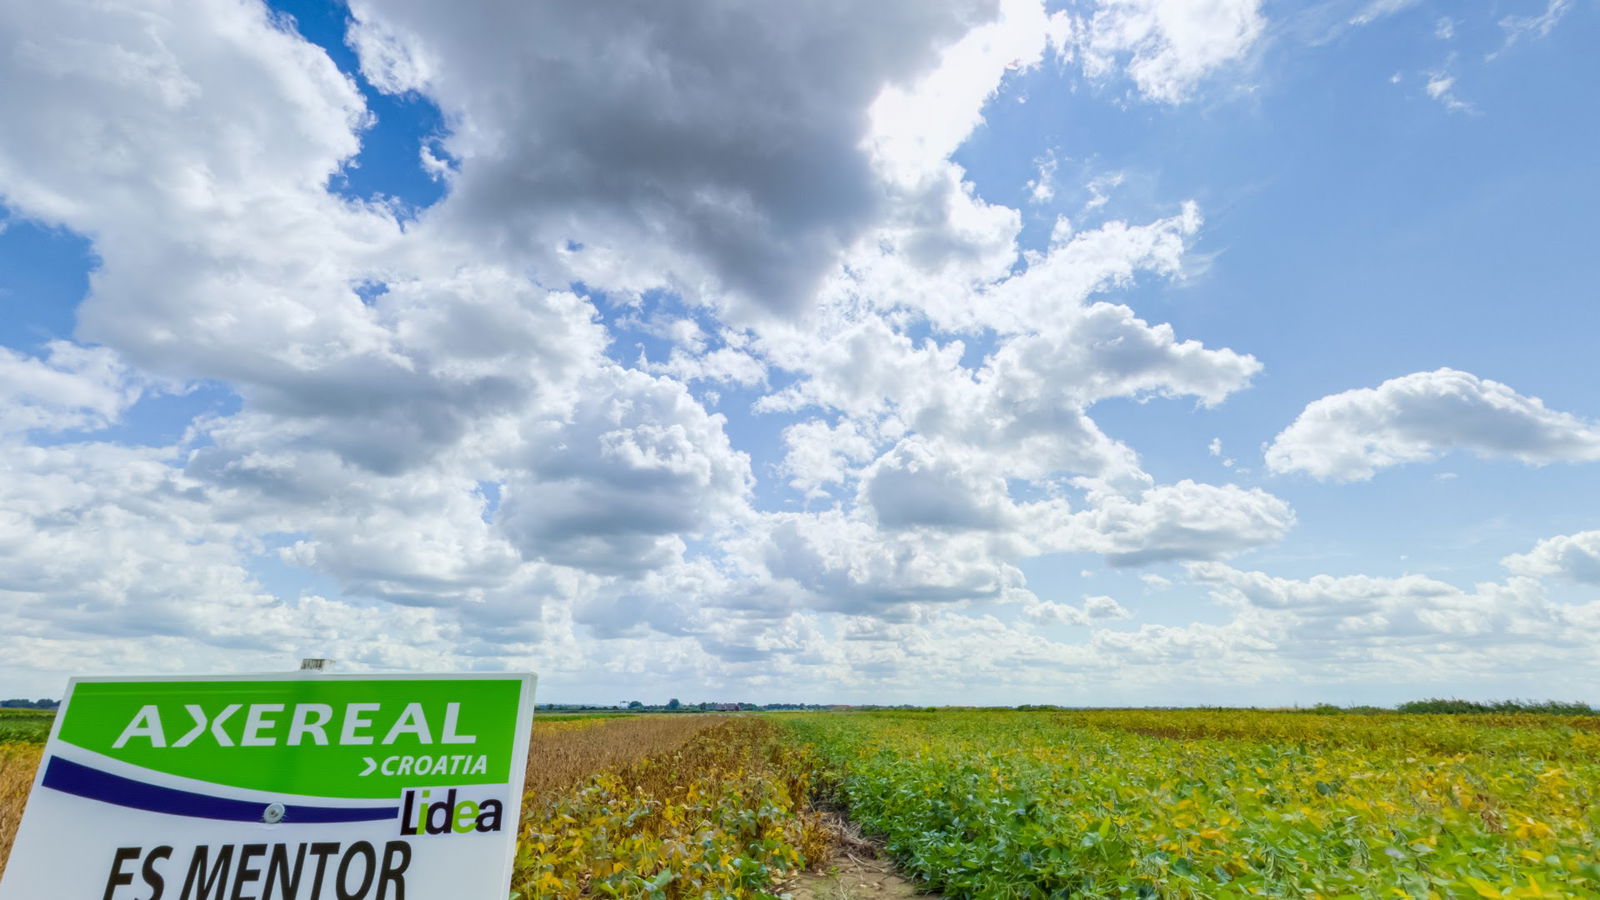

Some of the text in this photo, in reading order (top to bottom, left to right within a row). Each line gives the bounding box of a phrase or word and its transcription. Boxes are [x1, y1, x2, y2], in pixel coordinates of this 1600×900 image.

[112, 702, 477, 748] AXEREAL
[381, 755, 487, 775] CROATIA
[400, 789, 503, 835] Lidea
[180, 840, 412, 900] MENTOR
